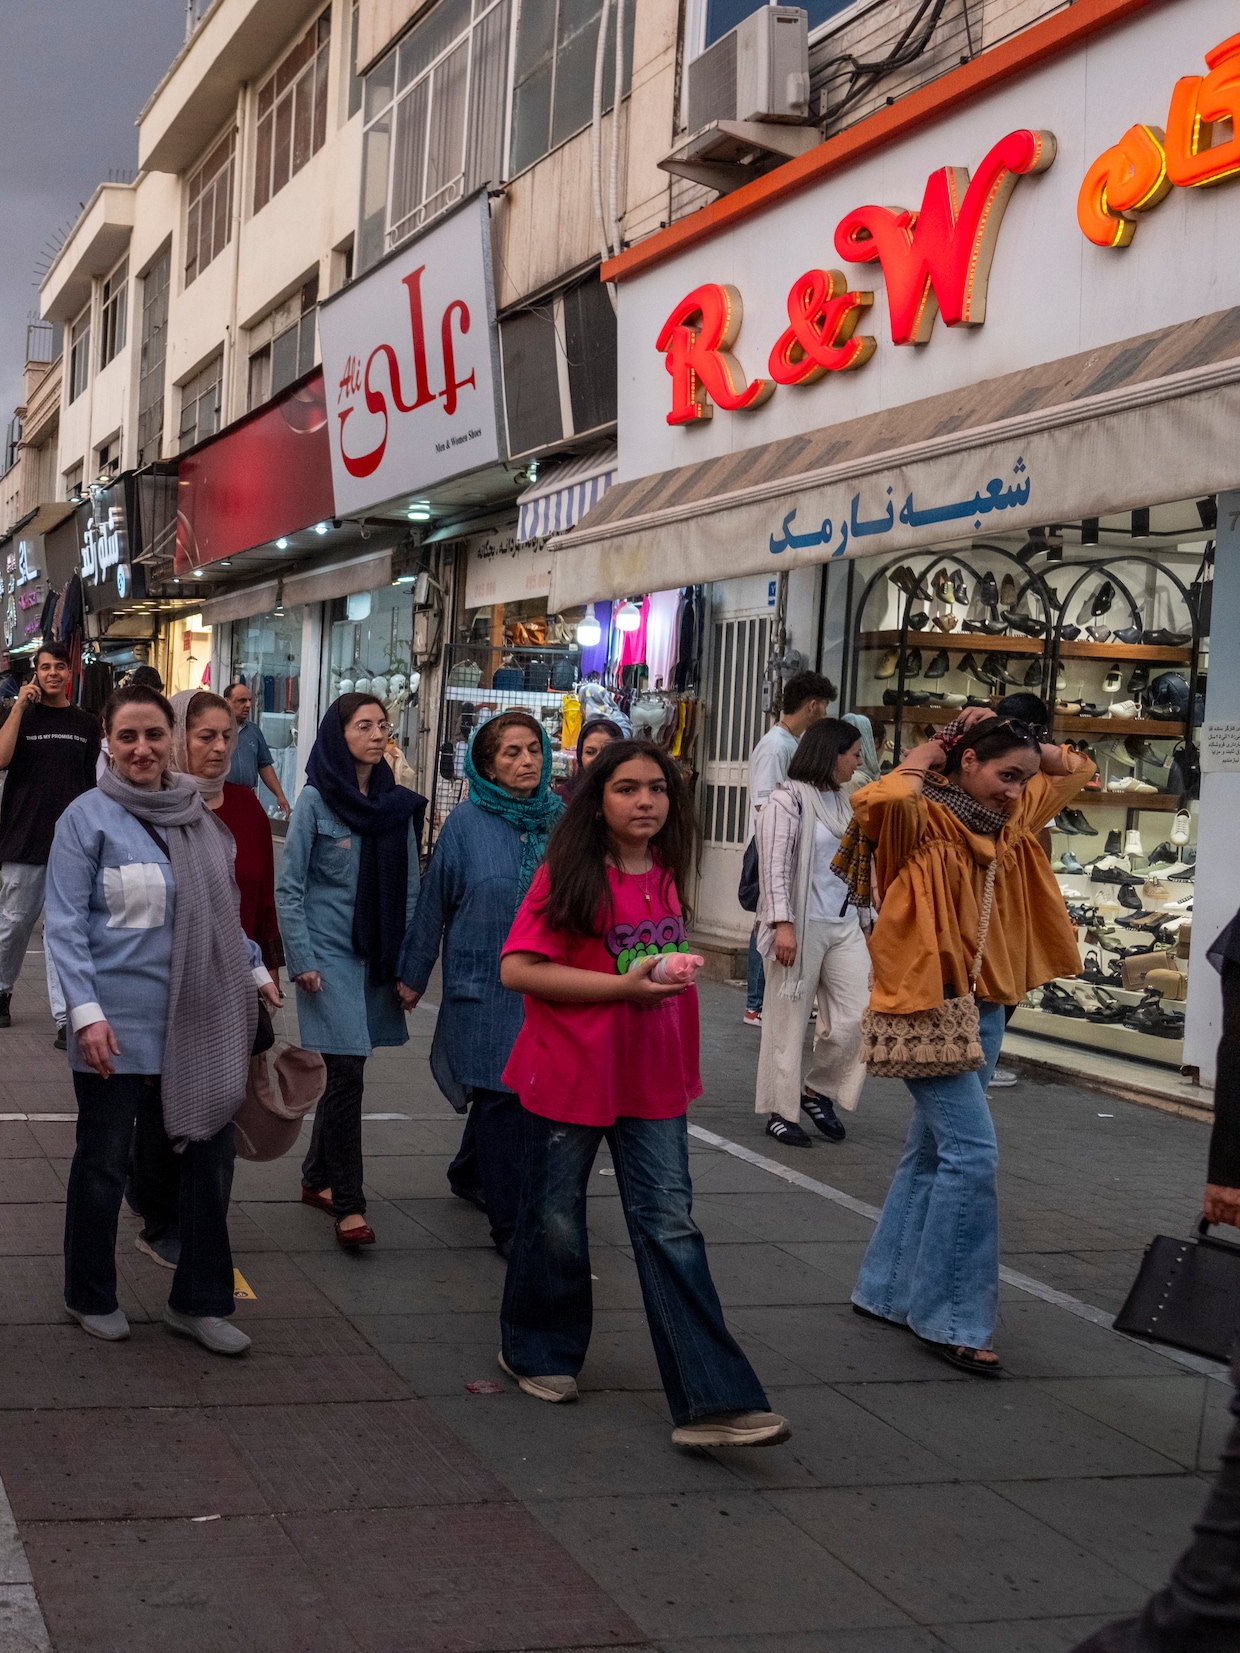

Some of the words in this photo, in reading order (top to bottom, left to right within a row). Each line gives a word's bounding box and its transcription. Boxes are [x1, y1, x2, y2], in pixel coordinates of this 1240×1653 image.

[655, 283, 775, 426] R
[768, 269, 877, 385] &
[834, 129, 1057, 345] W
[338, 264, 476, 478] علی
[769, 486, 895, 557] نارمک
[899, 456, 1030, 530] شعبه
